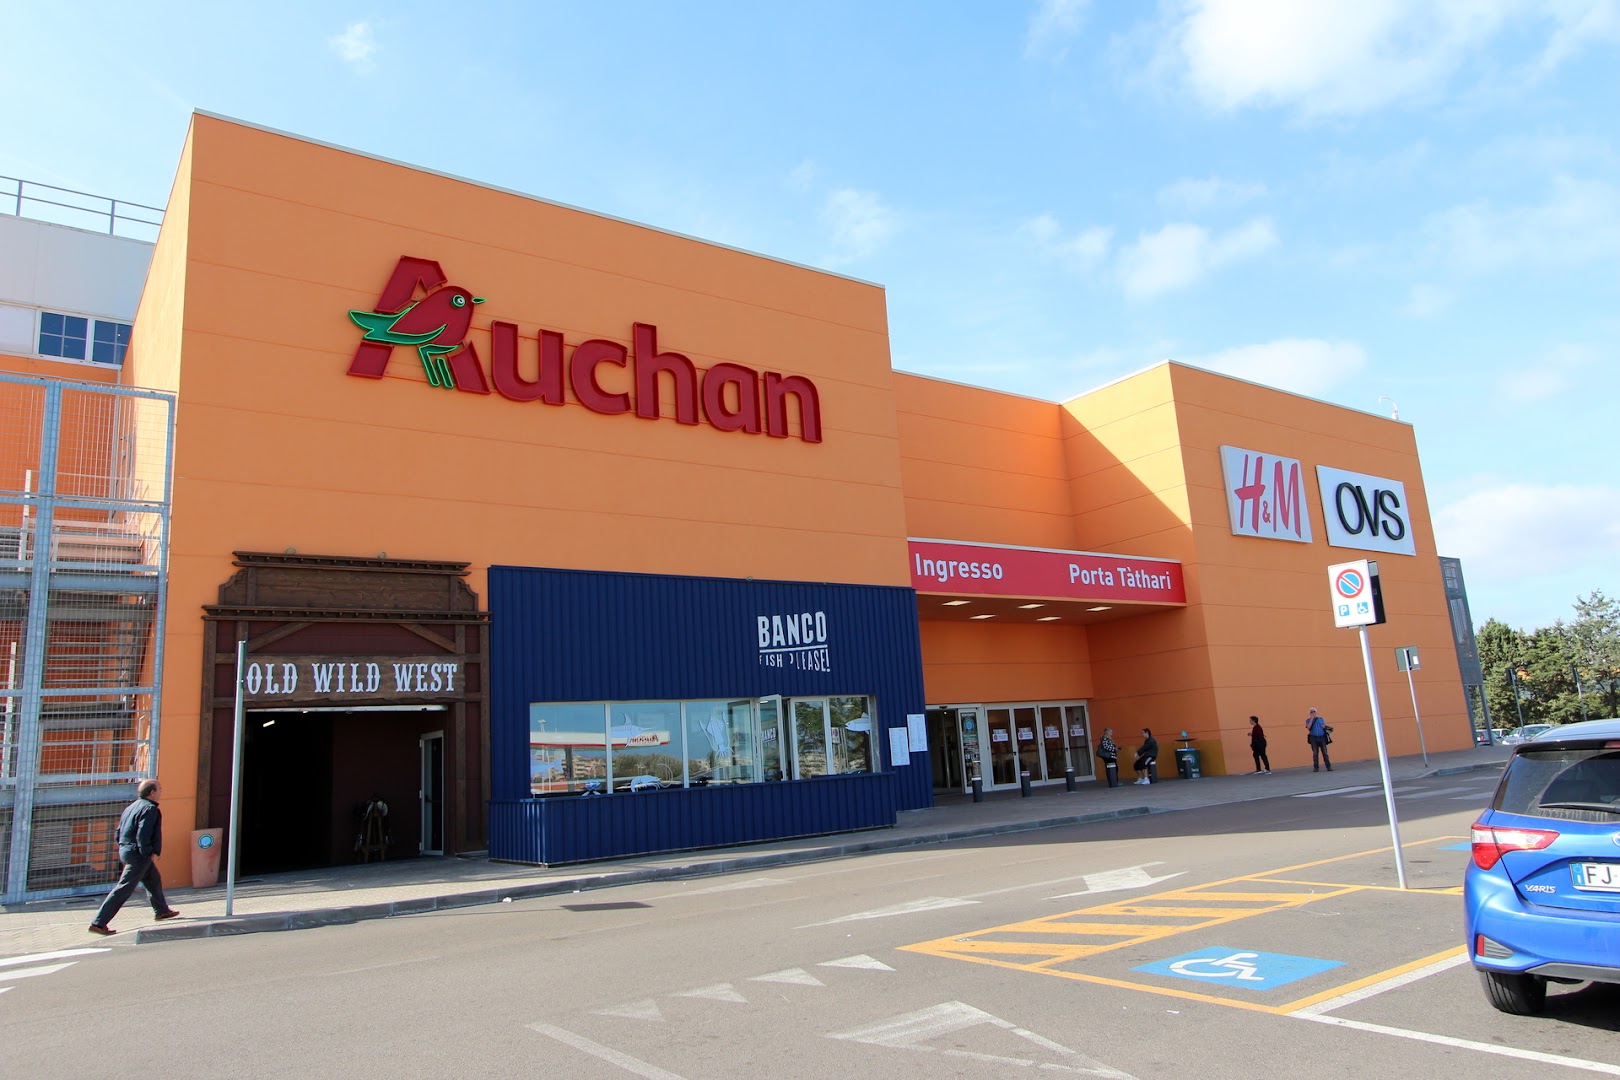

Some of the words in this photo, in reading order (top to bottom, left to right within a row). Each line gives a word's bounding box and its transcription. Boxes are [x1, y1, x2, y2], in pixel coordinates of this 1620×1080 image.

[345, 255, 824, 444] Auchan
[1233, 453, 1302, 540] H&M
[1335, 481, 1406, 542] OVS
[914, 552, 1004, 584] Ingresso
[1068, 563, 1115, 587] Porta
[1116, 566, 1172, 590] Tàthari
[757, 610, 827, 648] BANCO
[246, 662, 299, 695] OLD
[311, 662, 381, 694] WILD
[392, 662, 458, 693] WEST
[1524, 884, 1556, 894] YARIS
